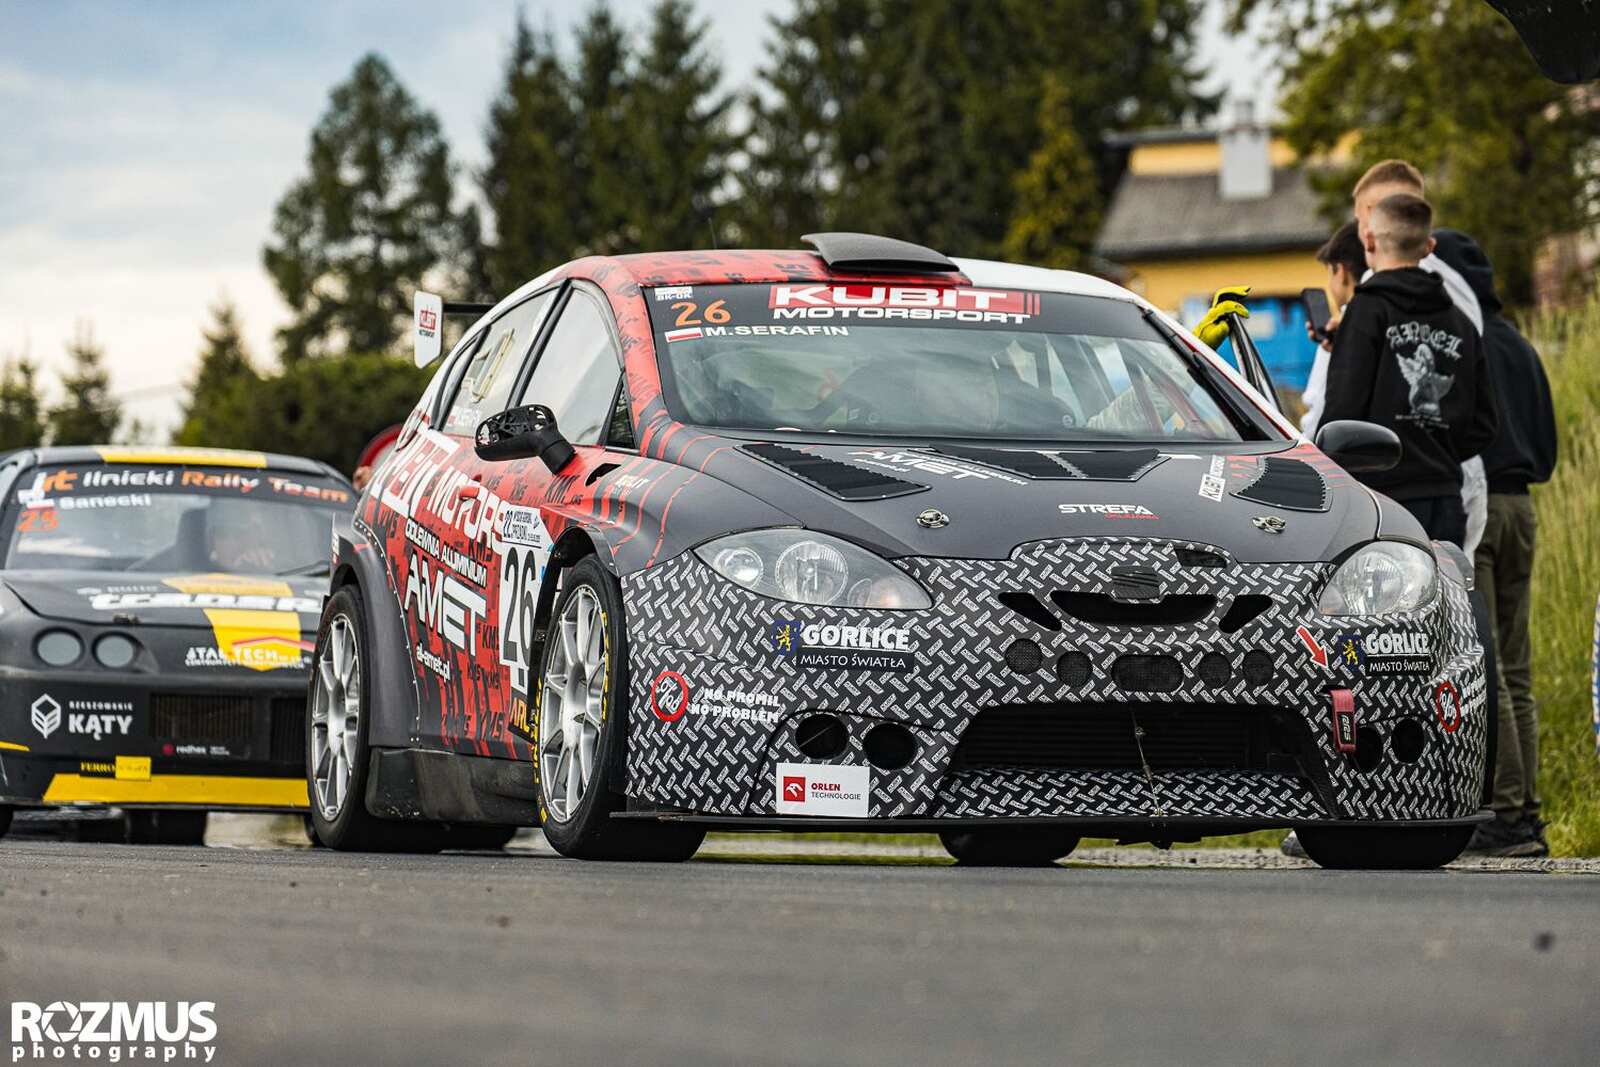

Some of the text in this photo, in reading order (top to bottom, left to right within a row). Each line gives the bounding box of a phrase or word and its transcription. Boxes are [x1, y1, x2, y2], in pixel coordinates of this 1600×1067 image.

[773, 284, 1008, 309] KUBIT
[671, 300, 732, 327] 26
[773, 306, 1031, 325] MOTORSPORT
[705, 325, 850, 337] M.SERAFIN
[82, 470, 175, 487] Ilnicki
[181, 470, 260, 493] Rally
[267, 476, 349, 503] Team
[1058, 504, 1154, 515] STREFA
[404, 553, 487, 656] AMET
[503, 547, 536, 666] 26
[800, 624, 910, 650] GORLICE
[1365, 632, 1430, 654] GORLICE
[800, 653, 906, 668] MIASTO ŚWIATŁA
[1369, 659, 1430, 672] MIASTO ŚWIATŁA
[727, 690, 781, 707] PROMIL
[712, 705, 779, 724] PROBLEM
[68, 713, 133, 741] KĄTY
[811, 783, 841, 791] ORLEN
[811, 792, 862, 800] TECHNOLOGIE
